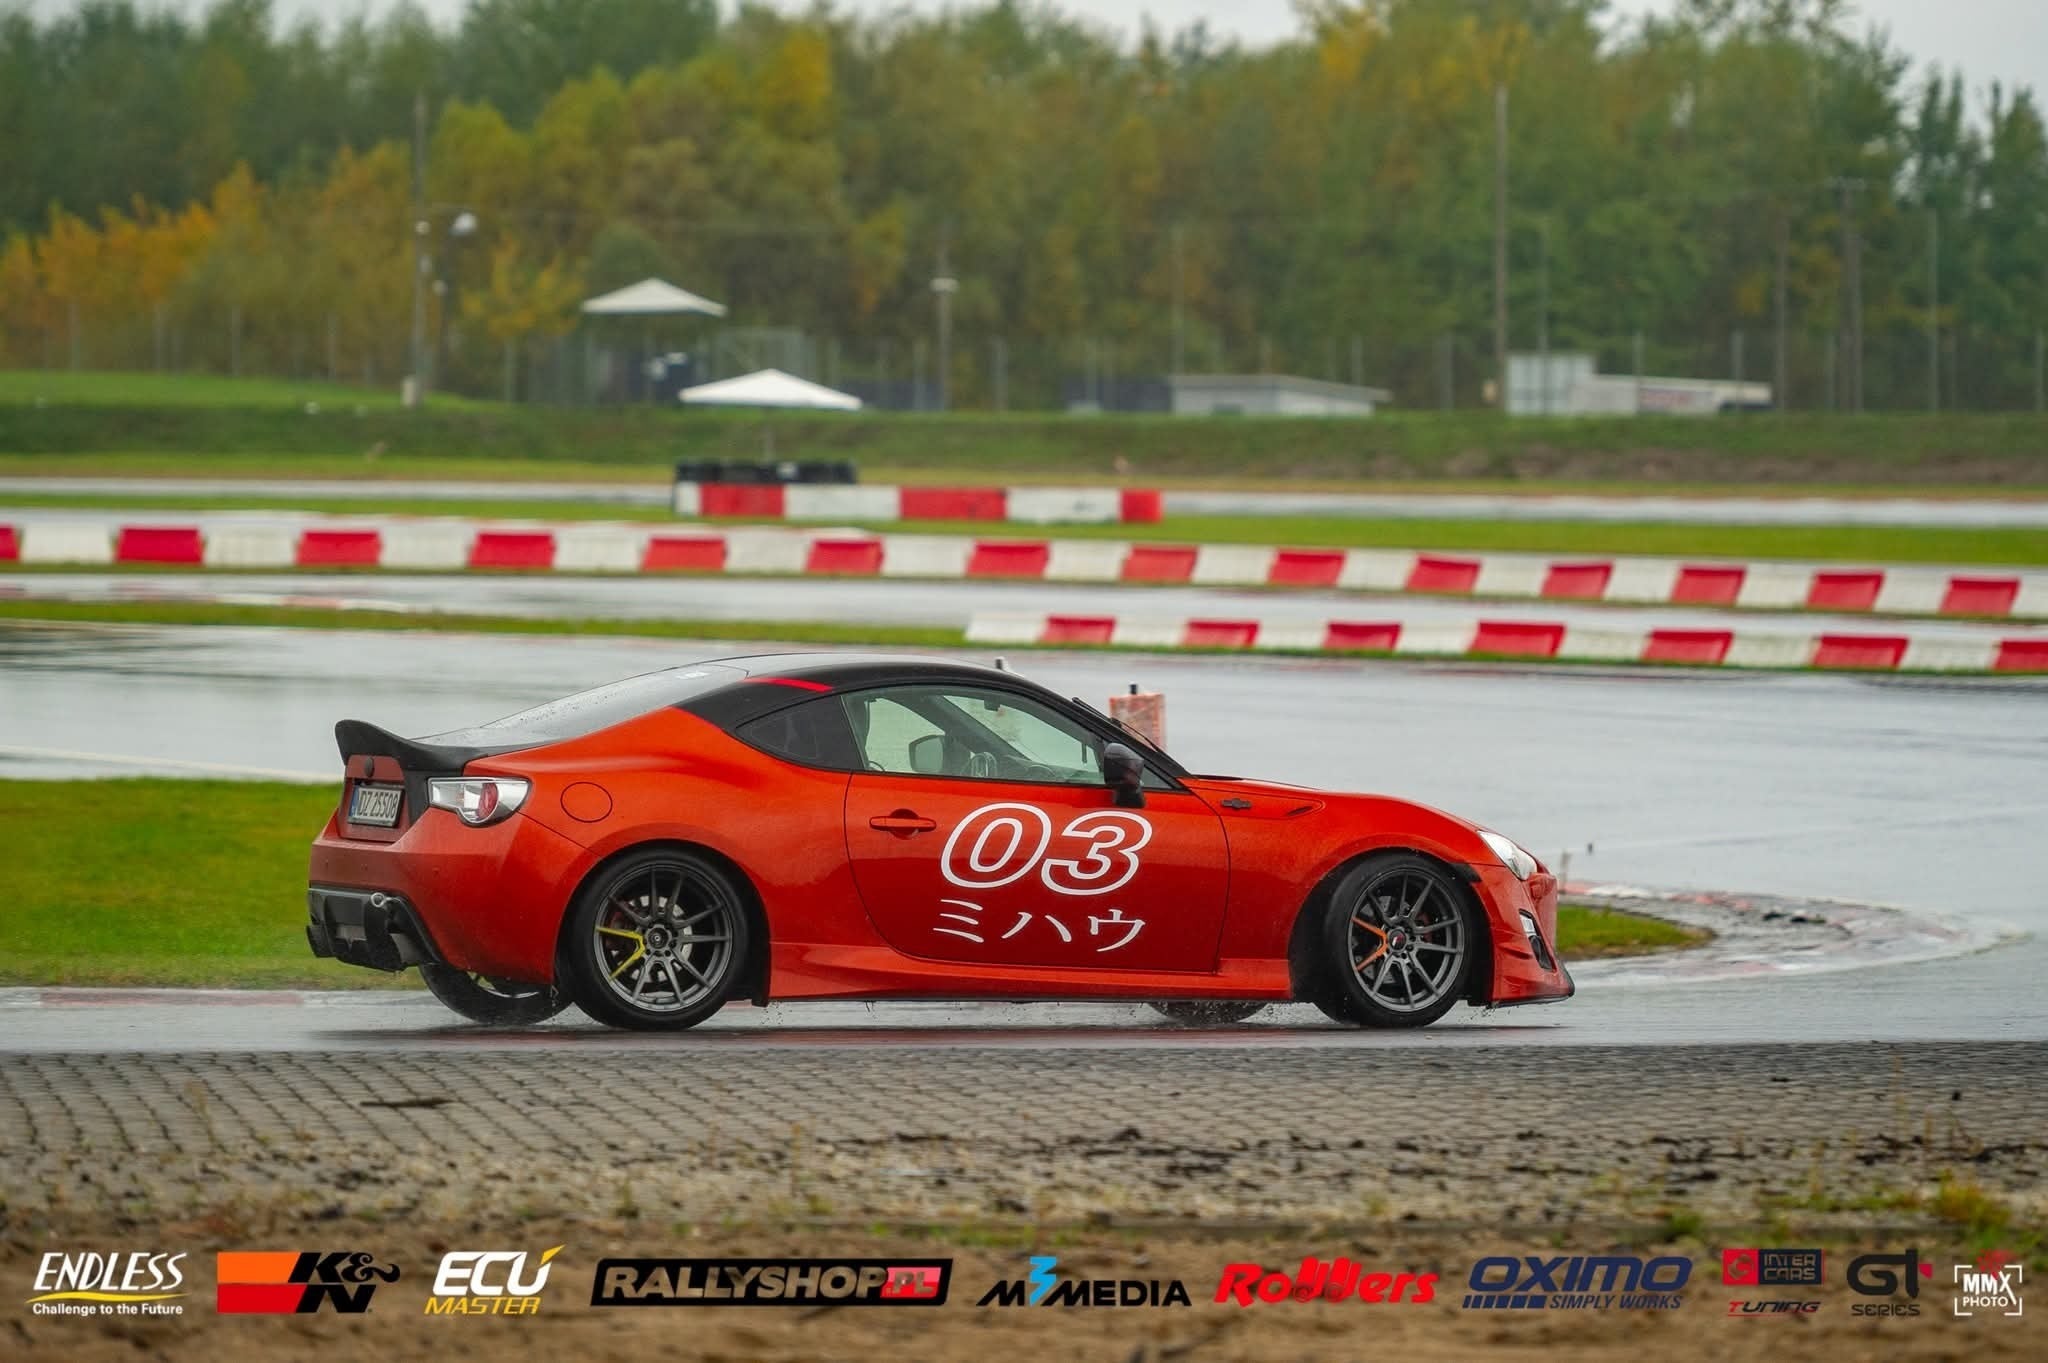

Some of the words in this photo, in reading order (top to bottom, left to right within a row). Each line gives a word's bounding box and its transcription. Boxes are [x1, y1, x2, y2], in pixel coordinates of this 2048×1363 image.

[941, 802, 1152, 895] 03
[933, 898, 1145, 952] ミハウ
